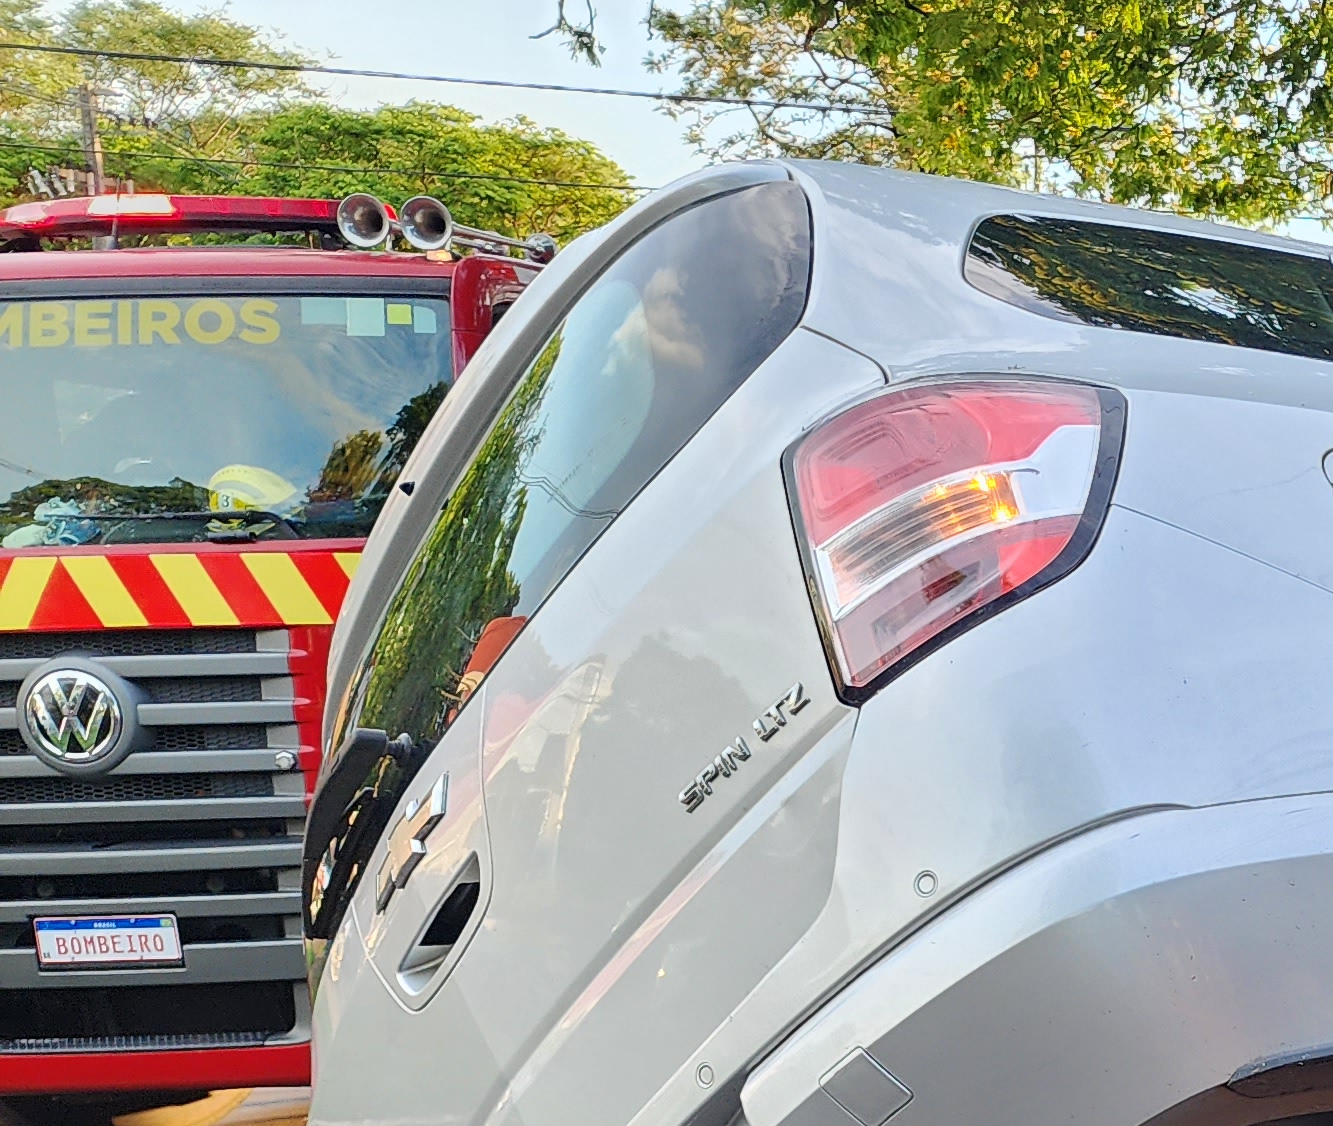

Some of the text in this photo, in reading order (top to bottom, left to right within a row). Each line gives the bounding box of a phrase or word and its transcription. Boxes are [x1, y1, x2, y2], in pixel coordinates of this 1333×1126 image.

[678, 681, 812, 814] SPIN LTZ
[56, 933, 164, 955] BOMBEIRO
